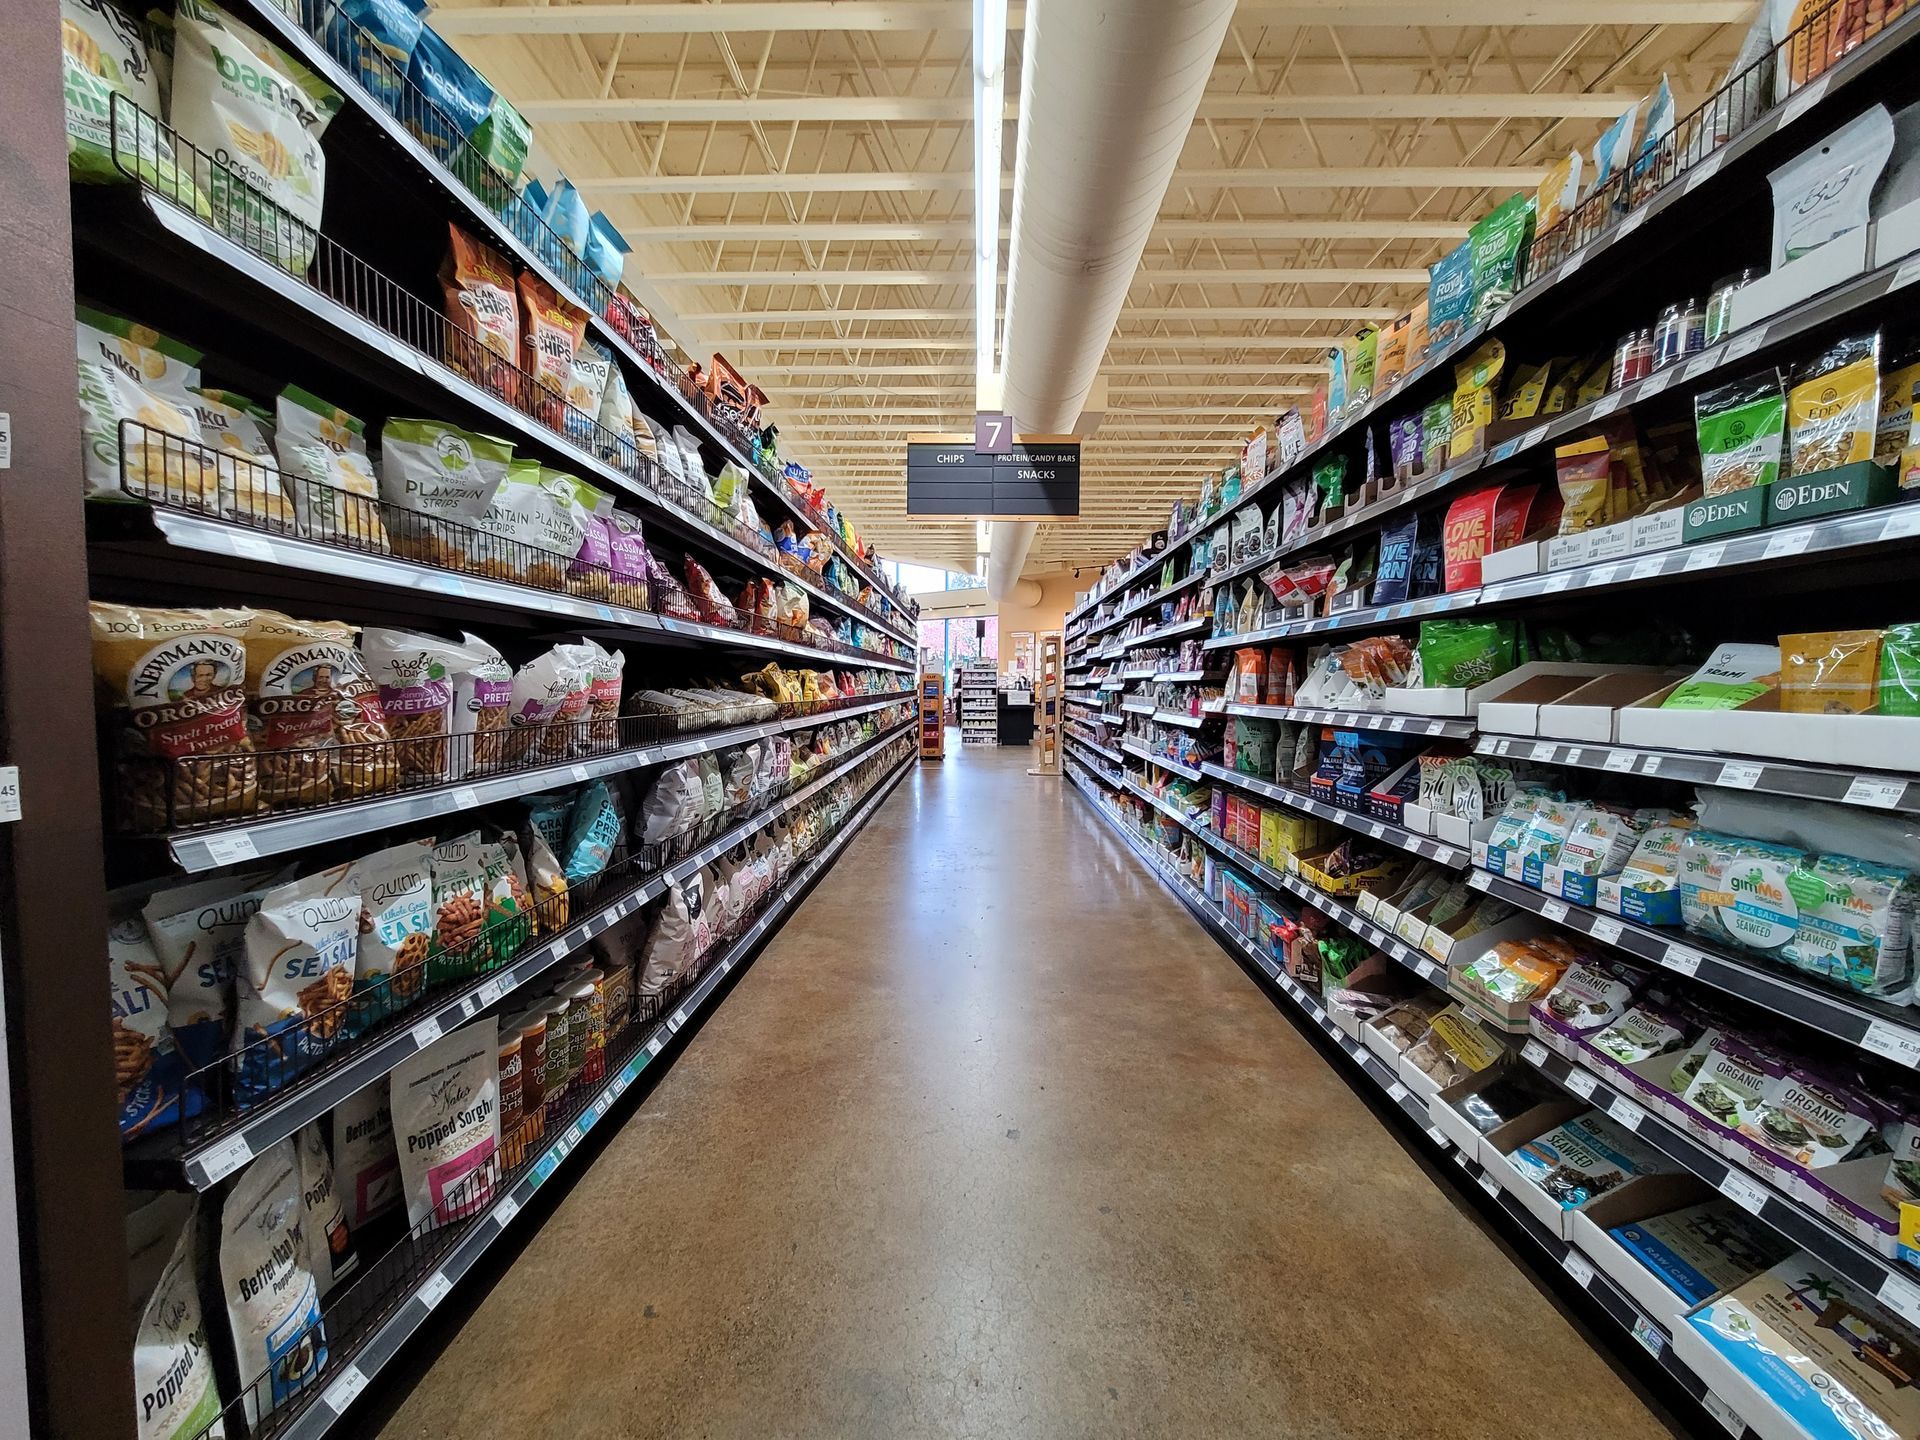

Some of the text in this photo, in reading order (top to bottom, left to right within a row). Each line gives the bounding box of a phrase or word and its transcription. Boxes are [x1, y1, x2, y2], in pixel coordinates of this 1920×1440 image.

[214, 148, 273, 192] Organic
[1808, 400, 1845, 420] EDEN
[985, 421, 1002, 448] 7
[936, 454, 965, 464] CHIPS
[1017, 470, 1056, 479] SNACKS
[405, 479, 483, 500] PLANTAIN
[1798, 481, 1850, 506] EDEN
[422, 499, 460, 508] STRIPS
[1707, 501, 1748, 522] EDEN
[482, 509, 529, 525] ANTAIN
[1638, 519, 1677, 535] HARVEST ROAST
[480, 521, 516, 535] STRIPS
[543, 529, 572, 546] STRIPS
[611, 540, 644, 555] CASSAVA
[134, 640, 233, 698] NEWMAN'S
[265, 647, 346, 690] NEWMAN'S
[1454, 658, 1484, 672] INKA
[1454, 664, 1493, 681] CORN
[483, 692, 513, 704] PRETZ
[597, 688, 621, 698] PRETZ
[133, 688, 246, 728] ORGANICS
[1457, 788, 1478, 812] pili
[1880, 787, 1901, 796] $3.59
[595, 820, 618, 836] PRET
[1561, 854, 1583, 868] SEAWEED
[1621, 870, 1643, 882] SEAWEED
[431, 884, 447, 903] YE
[1709, 893, 1731, 904] PACK
[1731, 877, 1782, 901] gimMe
[1754, 895, 1783, 908] ORGANIC
[1825, 892, 1873, 912] imMe
[1737, 904, 1780, 922] SEA SALT
[381, 914, 431, 944] SEA SA
[1736, 919, 1771, 938] SEAWEED
[1822, 923, 1849, 935] SALT
[1795, 930, 1837, 951] SEAWEED
[198, 954, 236, 988] SEA
[285, 953, 330, 980] SEA
[1569, 970, 1612, 994] ORGANIC
[111, 985, 151, 1018] ALT
[1627, 1015, 1664, 1038] ORGANIC
[1716, 1061, 1764, 1092] ORGANIC
[499, 1095, 523, 1114] Cris
[1784, 1088, 1847, 1130] ORGANIC
[408, 1116, 457, 1153] Popped
[457, 1099, 494, 1129] Sorgh
[1546, 1134, 1595, 1169] SEAWEED
[1747, 1155, 1776, 1179] ORGANIC
[305, 1179, 332, 1211] Popp
[1748, 1191, 1764, 1204] $0.99
[1825, 1203, 1858, 1231] ORGANIC
[239, 1243, 293, 1302] Better than
[1644, 1246, 1695, 1287] RAW CRU
[1764, 1292, 1792, 1314] ORGANIC
[142, 1341, 194, 1422] Popped
[1761, 1355, 1808, 1398] ORIGINAL
